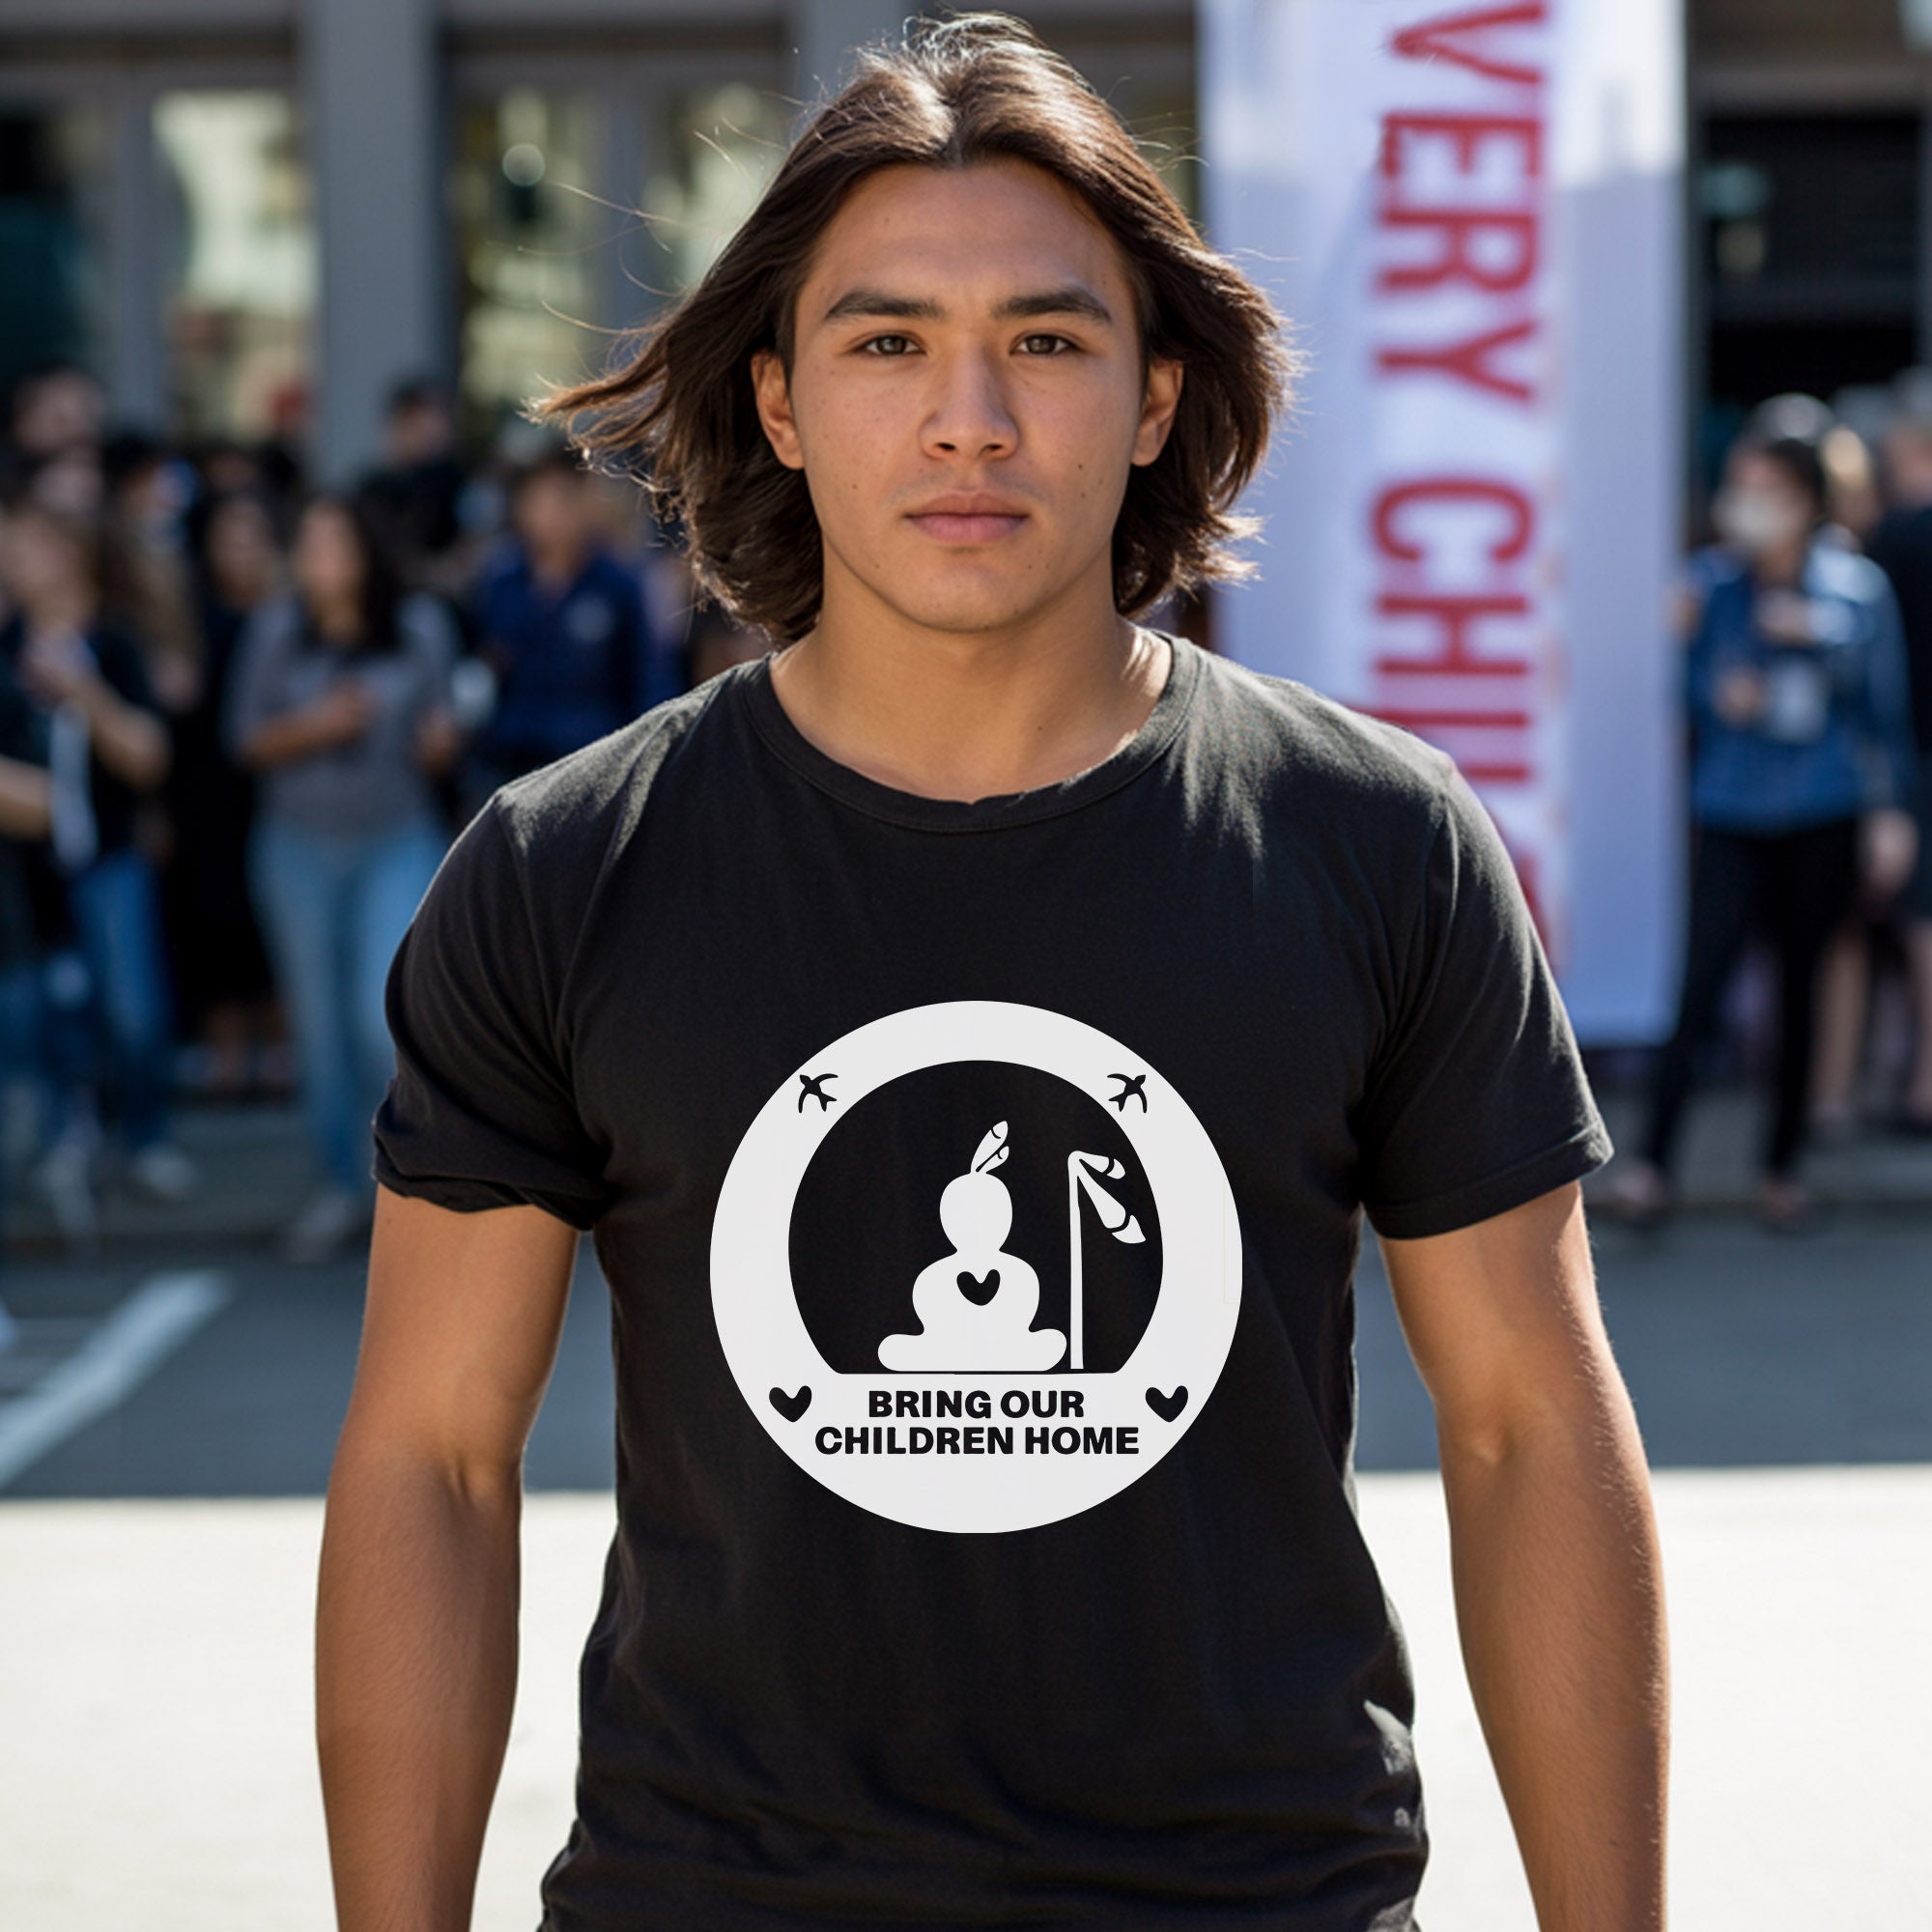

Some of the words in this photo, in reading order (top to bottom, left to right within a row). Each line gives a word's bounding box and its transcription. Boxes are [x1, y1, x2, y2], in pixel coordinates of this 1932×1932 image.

[868, 1389, 992, 1419] BRING
[1000, 1389, 1085, 1419] OUR
[814, 1426, 1014, 1456] CHILDREN
[1025, 1426, 1140, 1456] HOME
